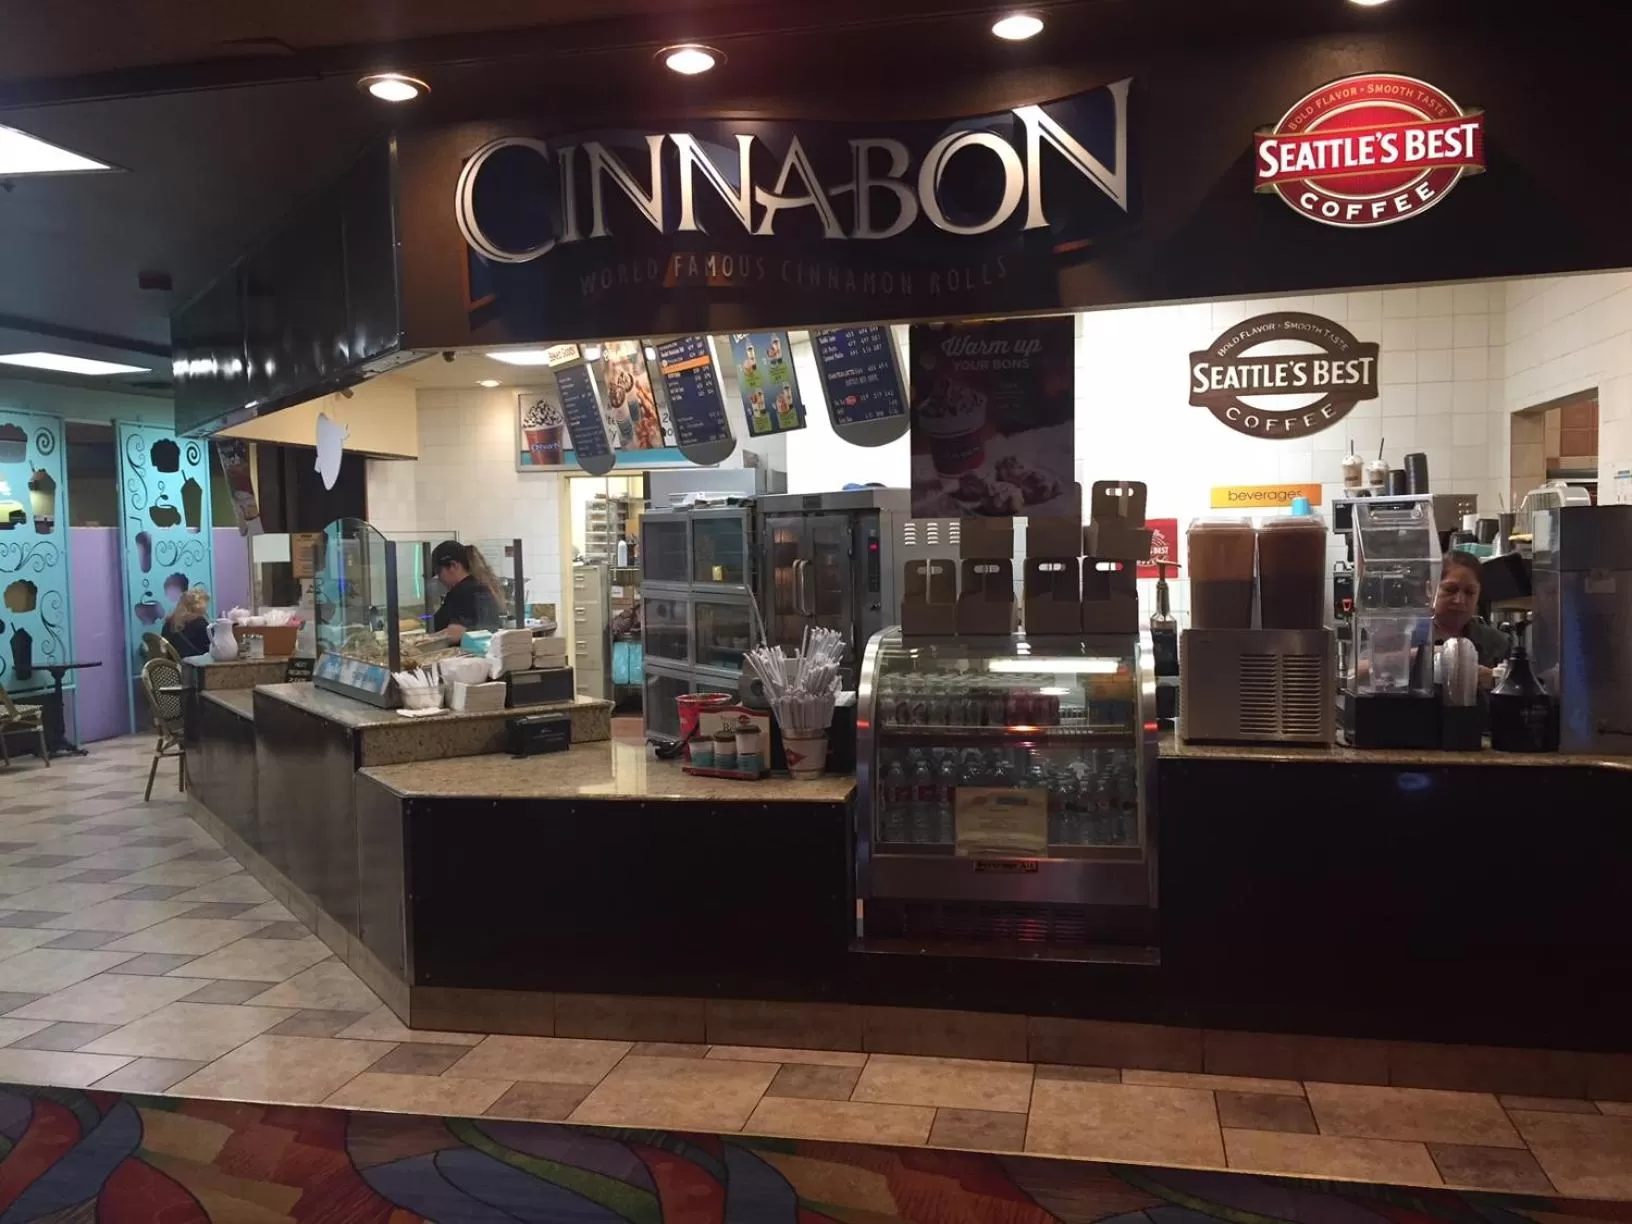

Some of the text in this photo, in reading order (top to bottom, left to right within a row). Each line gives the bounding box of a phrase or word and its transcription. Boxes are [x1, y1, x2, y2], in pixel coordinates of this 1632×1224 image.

[1288, 83, 1448, 130] BOLD FLAVOR SMOOTH TASTE
[1259, 123, 1479, 178] SEATTLE'S BEST
[455, 78, 1133, 263] CINNABON
[1300, 181, 1436, 220] COFFEE
[580, 255, 1008, 296] WORLD FAMOUS CINNAMON ROLLS
[941, 335, 1043, 357] Warm up
[1240, 323, 1275, 340] FLAVOR
[1284, 321, 1322, 333] SMOOTH
[1323, 328, 1349, 351] TASTE
[953, 358, 1030, 370] YOUR BONS
[1192, 357, 1374, 393] SEATTLE'S BEST
[1226, 403, 1336, 431] COFFEE
